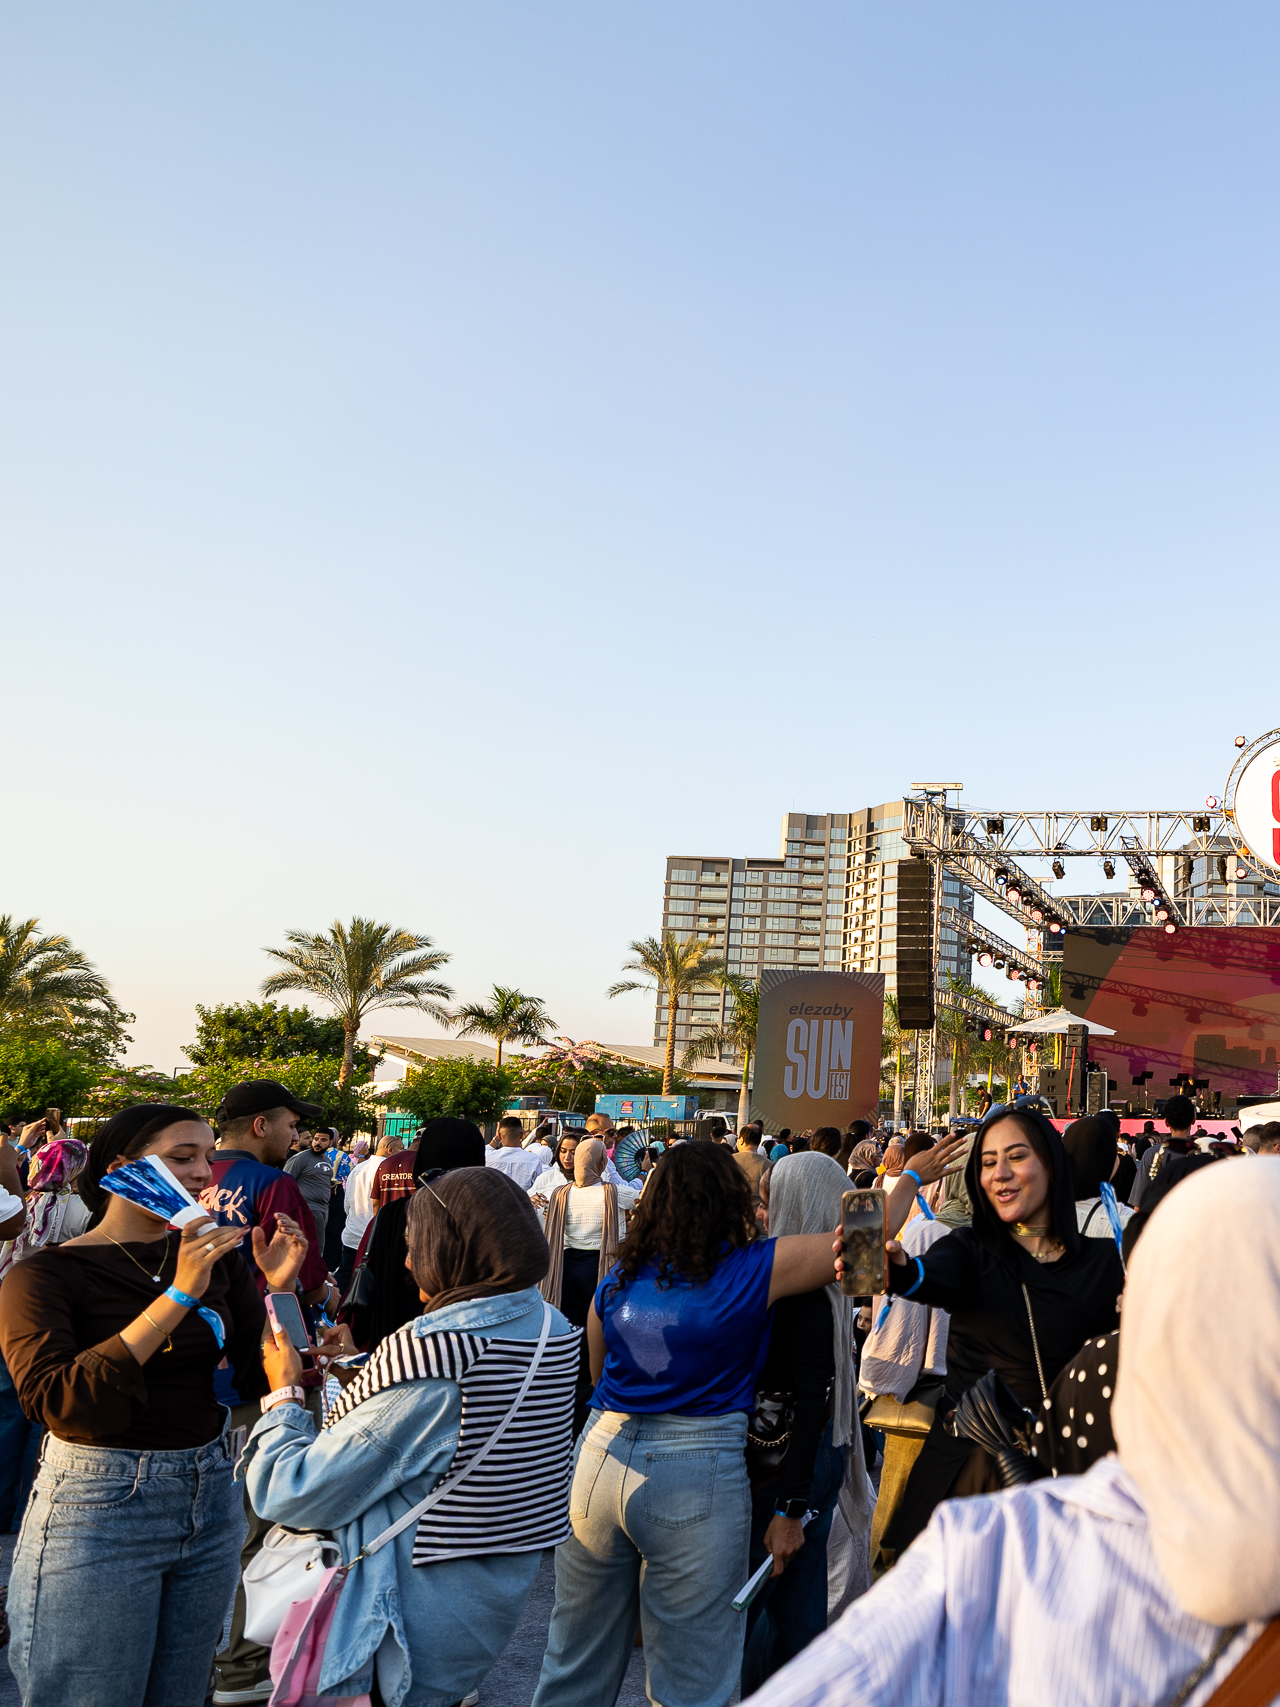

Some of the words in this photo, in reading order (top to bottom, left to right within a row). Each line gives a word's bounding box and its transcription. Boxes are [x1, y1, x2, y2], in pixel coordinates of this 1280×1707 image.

[788, 1002, 853, 1020] elezaby
[783, 1018, 853, 1099] SUN
[829, 1072, 850, 1099] FEST
